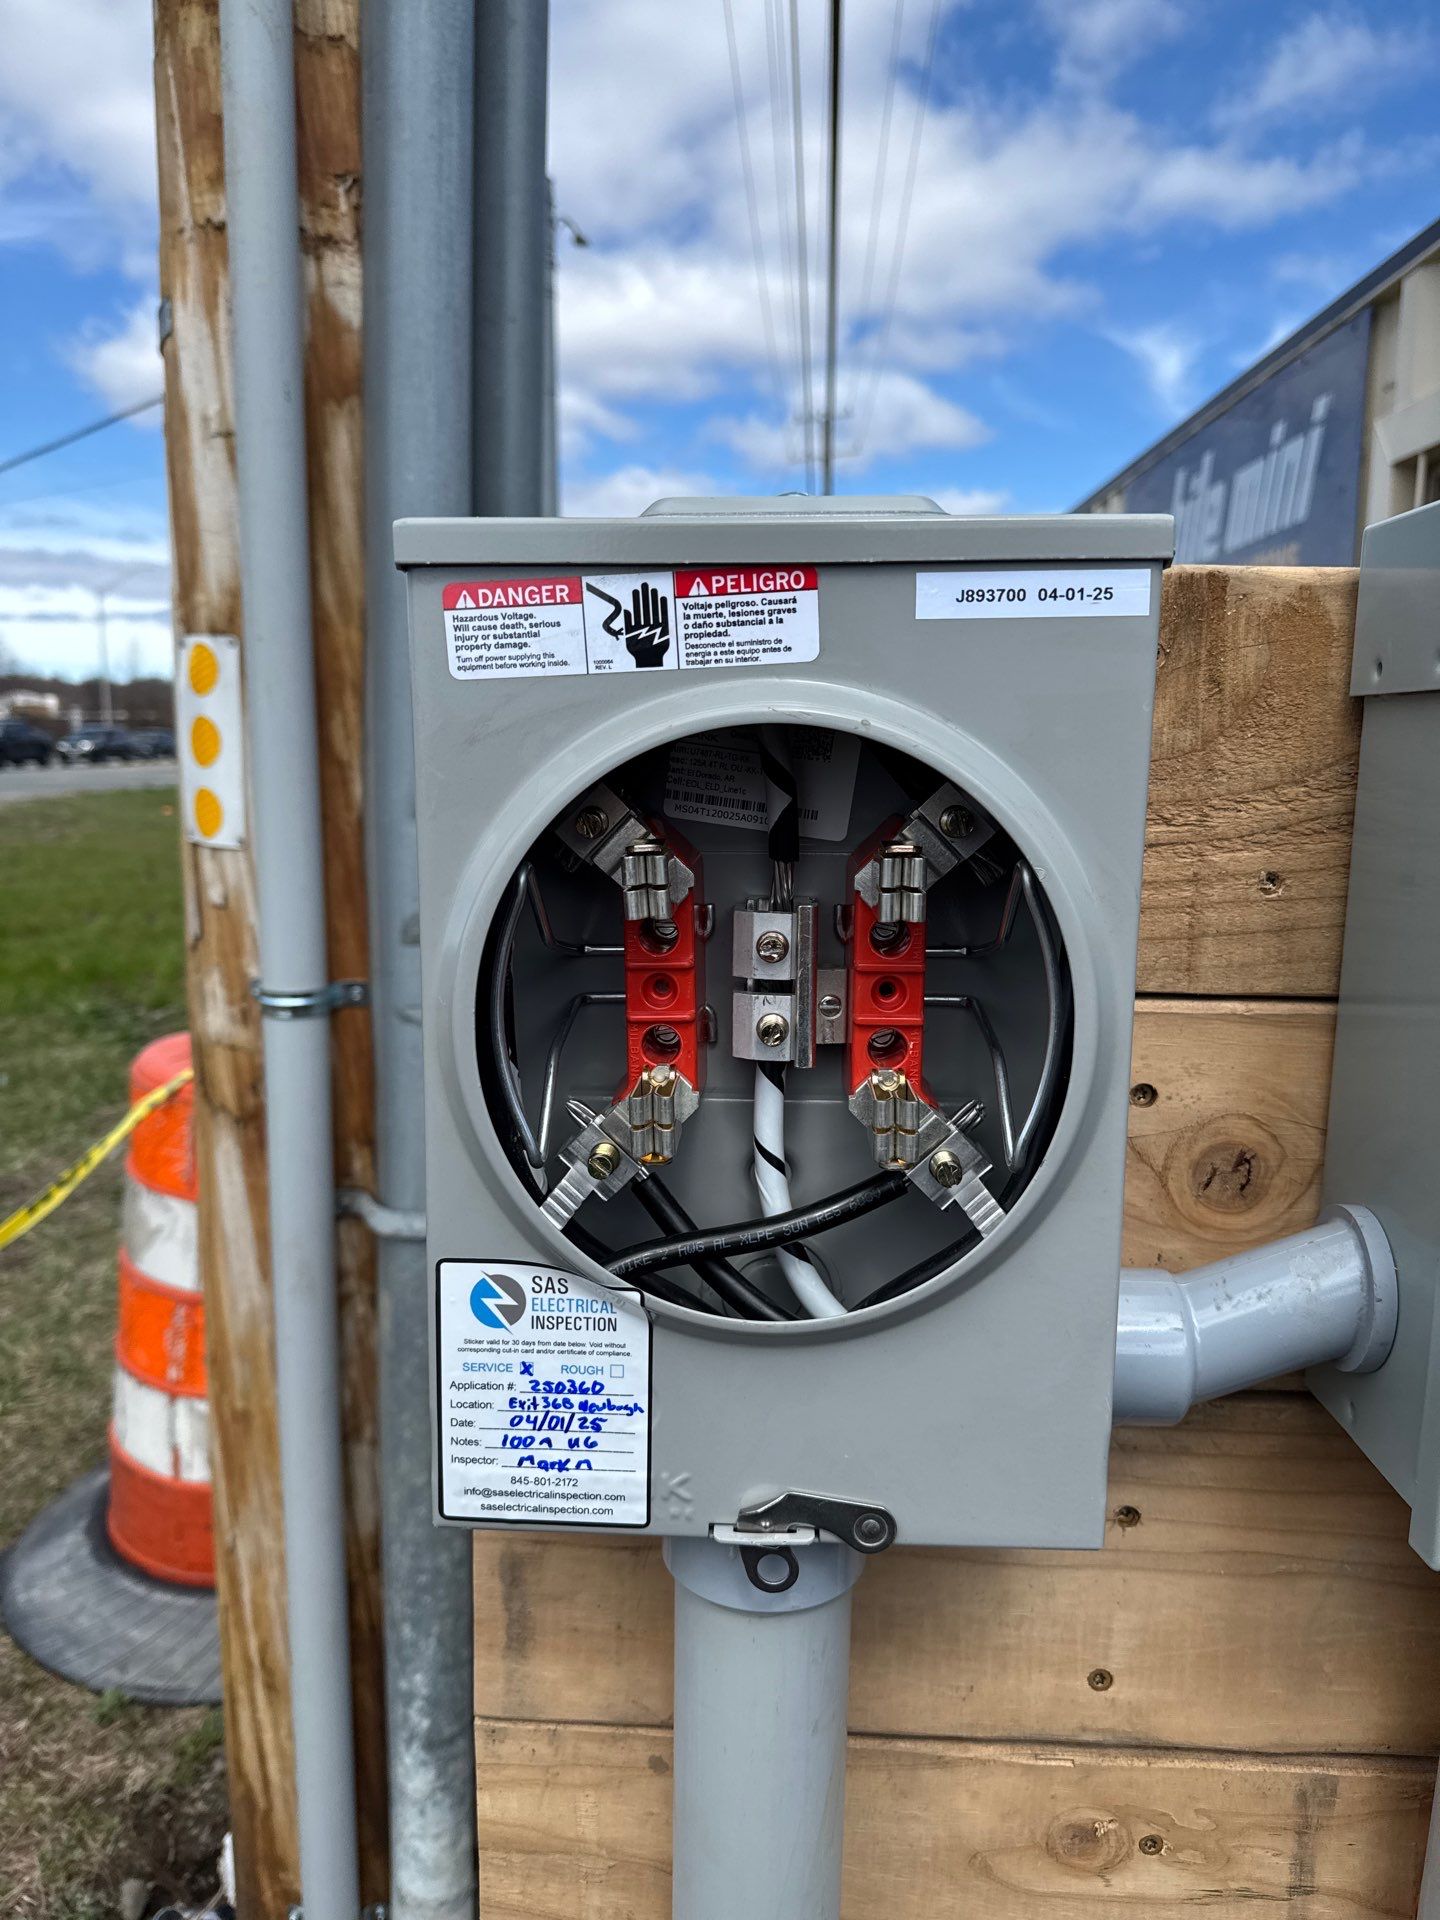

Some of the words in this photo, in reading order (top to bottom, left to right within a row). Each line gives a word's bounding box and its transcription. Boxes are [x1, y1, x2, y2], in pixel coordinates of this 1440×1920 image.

[711, 570, 805, 594] PELIGRO
[478, 585, 569, 607] DANGER
[956, 588, 1026, 603] J893700
[1037, 587, 1114, 602] 04-01-25
[682, 602, 712, 611] Voltaje
[715, 600, 758, 610] peligroso.
[761, 596, 797, 605] Causará
[453, 614, 499, 623] Hazardous
[501, 612, 536, 622] Voltage.
[683, 612, 691, 620] la
[693, 611, 726, 619] muerte,
[729, 609, 765, 617] lesiones
[767, 607, 797, 616] graves
[453, 624, 470, 632] Will
[472, 624, 497, 632] cause
[500, 622, 527, 631] death,
[529, 620, 561, 629] serious
[692, 620, 713, 629] daño
[716, 617, 766, 627] substancial
[454, 633, 479, 643] injury
[493, 630, 540, 640] substantial
[684, 629, 731, 641] propiedad.
[456, 643, 491, 653] property
[494, 641, 531, 651] damage.
[685, 641, 726, 649] Desconecte
[737, 647, 760, 655] equipo
[457, 655, 472, 663] Turn
[485, 655, 506, 663] power
[508, 653, 541, 662] supplying
[686, 658, 712, 666] trabajar
[457, 662, 493, 671] equipment
[495, 661, 517, 669] before
[519, 660, 545, 669] working
[548, 659, 570, 667] inside.
[678, 1240, 705, 1257] AWG
[713, 1237, 731, 1251] AL
[739, 1229, 775, 1246] XLPE
[782, 1218, 809, 1236] SUN
[816, 1208, 841, 1224] RES
[532, 1275, 569, 1295] SAS
[532, 1298, 617, 1314] ELECTRICAL
[531, 1315, 617, 1332] INSPECTION
[521, 1339, 536, 1347] days
[596, 1350, 632, 1358] compliance.
[462, 1363, 513, 1373] SERVICE
[561, 1364, 604, 1375] ROUGH
[450, 1381, 504, 1393] Application
[507, 1382, 516, 1391] #:
[450, 1400, 494, 1410] Location:
[508, 1396, 540, 1411] Exit
[541, 1396, 575, 1410] 36B
[450, 1418, 476, 1428] Date:
[509, 1410, 608, 1433] 04/01/25
[450, 1437, 482, 1447] Notes:
[451, 1455, 499, 1467] Inspector:
[510, 1476, 579, 1488] 845-801-2172
[464, 1487, 626, 1502] info@saselectricalinspection.com
[480, 1502, 614, 1516] saselectricalinspection.com
